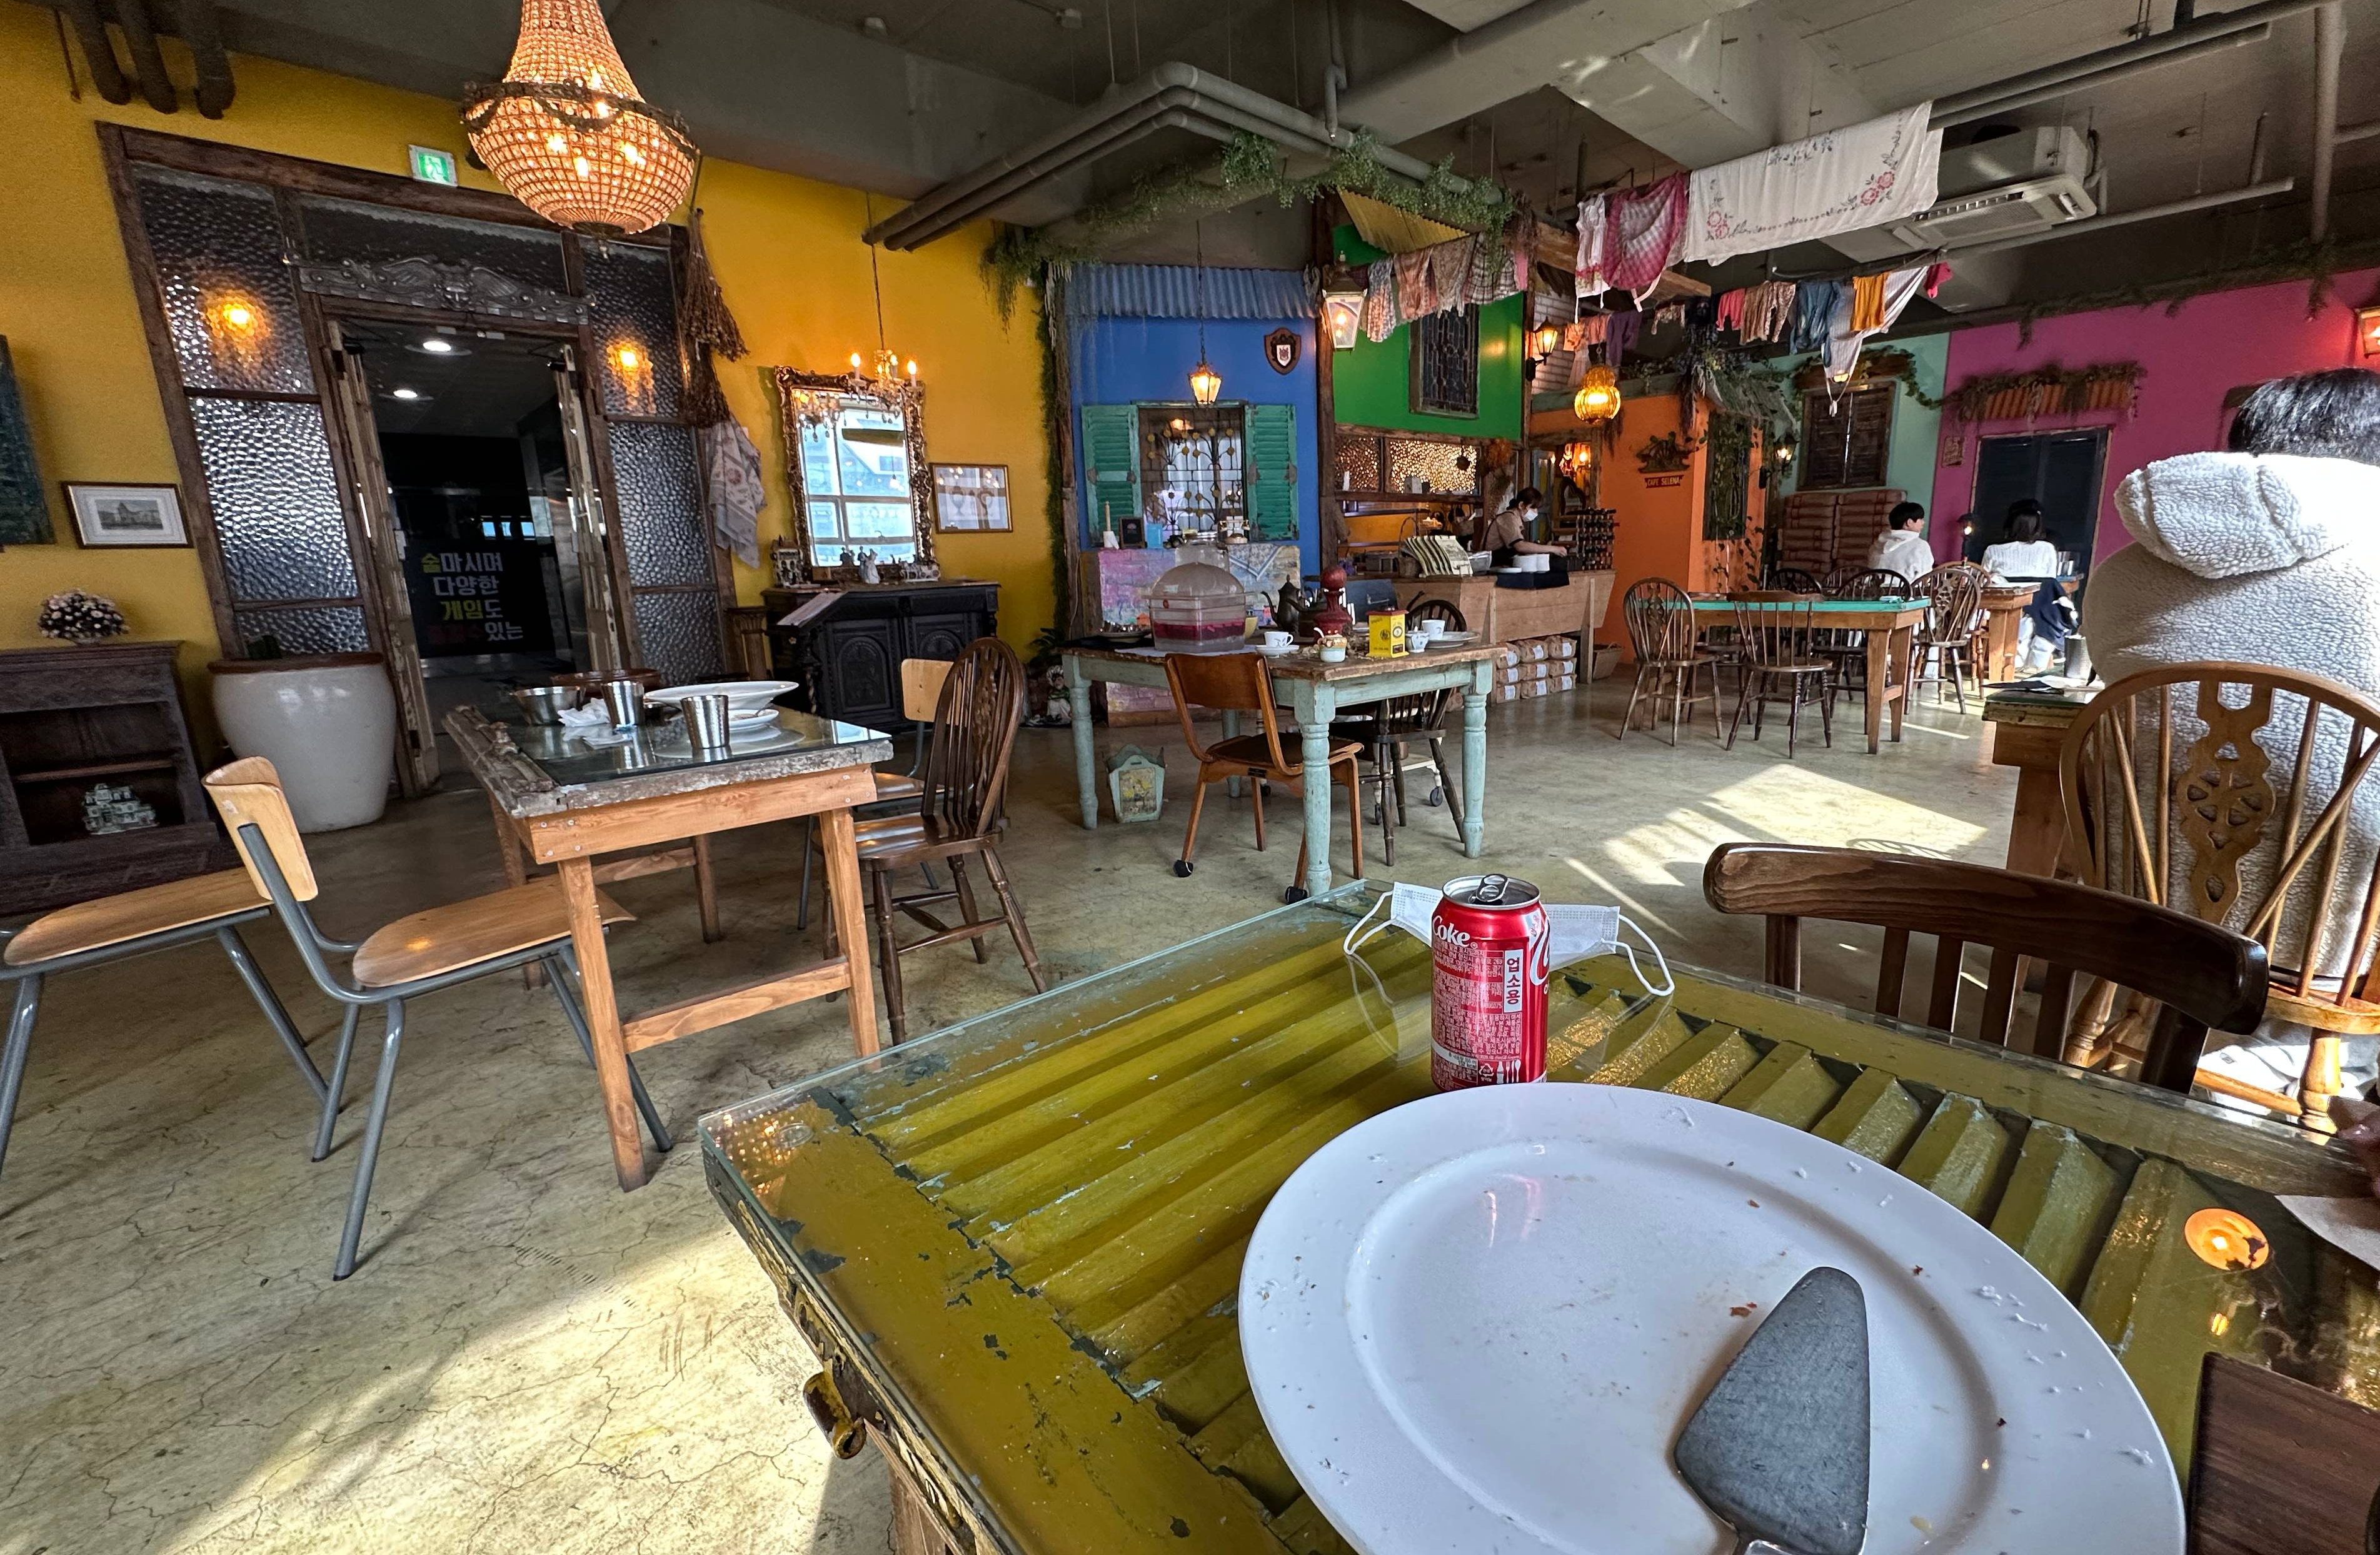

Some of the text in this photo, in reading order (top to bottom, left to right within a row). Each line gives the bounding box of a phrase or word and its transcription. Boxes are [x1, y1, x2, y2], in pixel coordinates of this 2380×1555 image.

[421, 553, 503, 573] 술마시며
[433, 576, 499, 596] 다양한
[441, 600, 503, 620] 게임도
[485, 622, 523, 641] 있는
[1432, 915, 1470, 947] Coke
[1507, 957, 1520, 1005] 업소용
